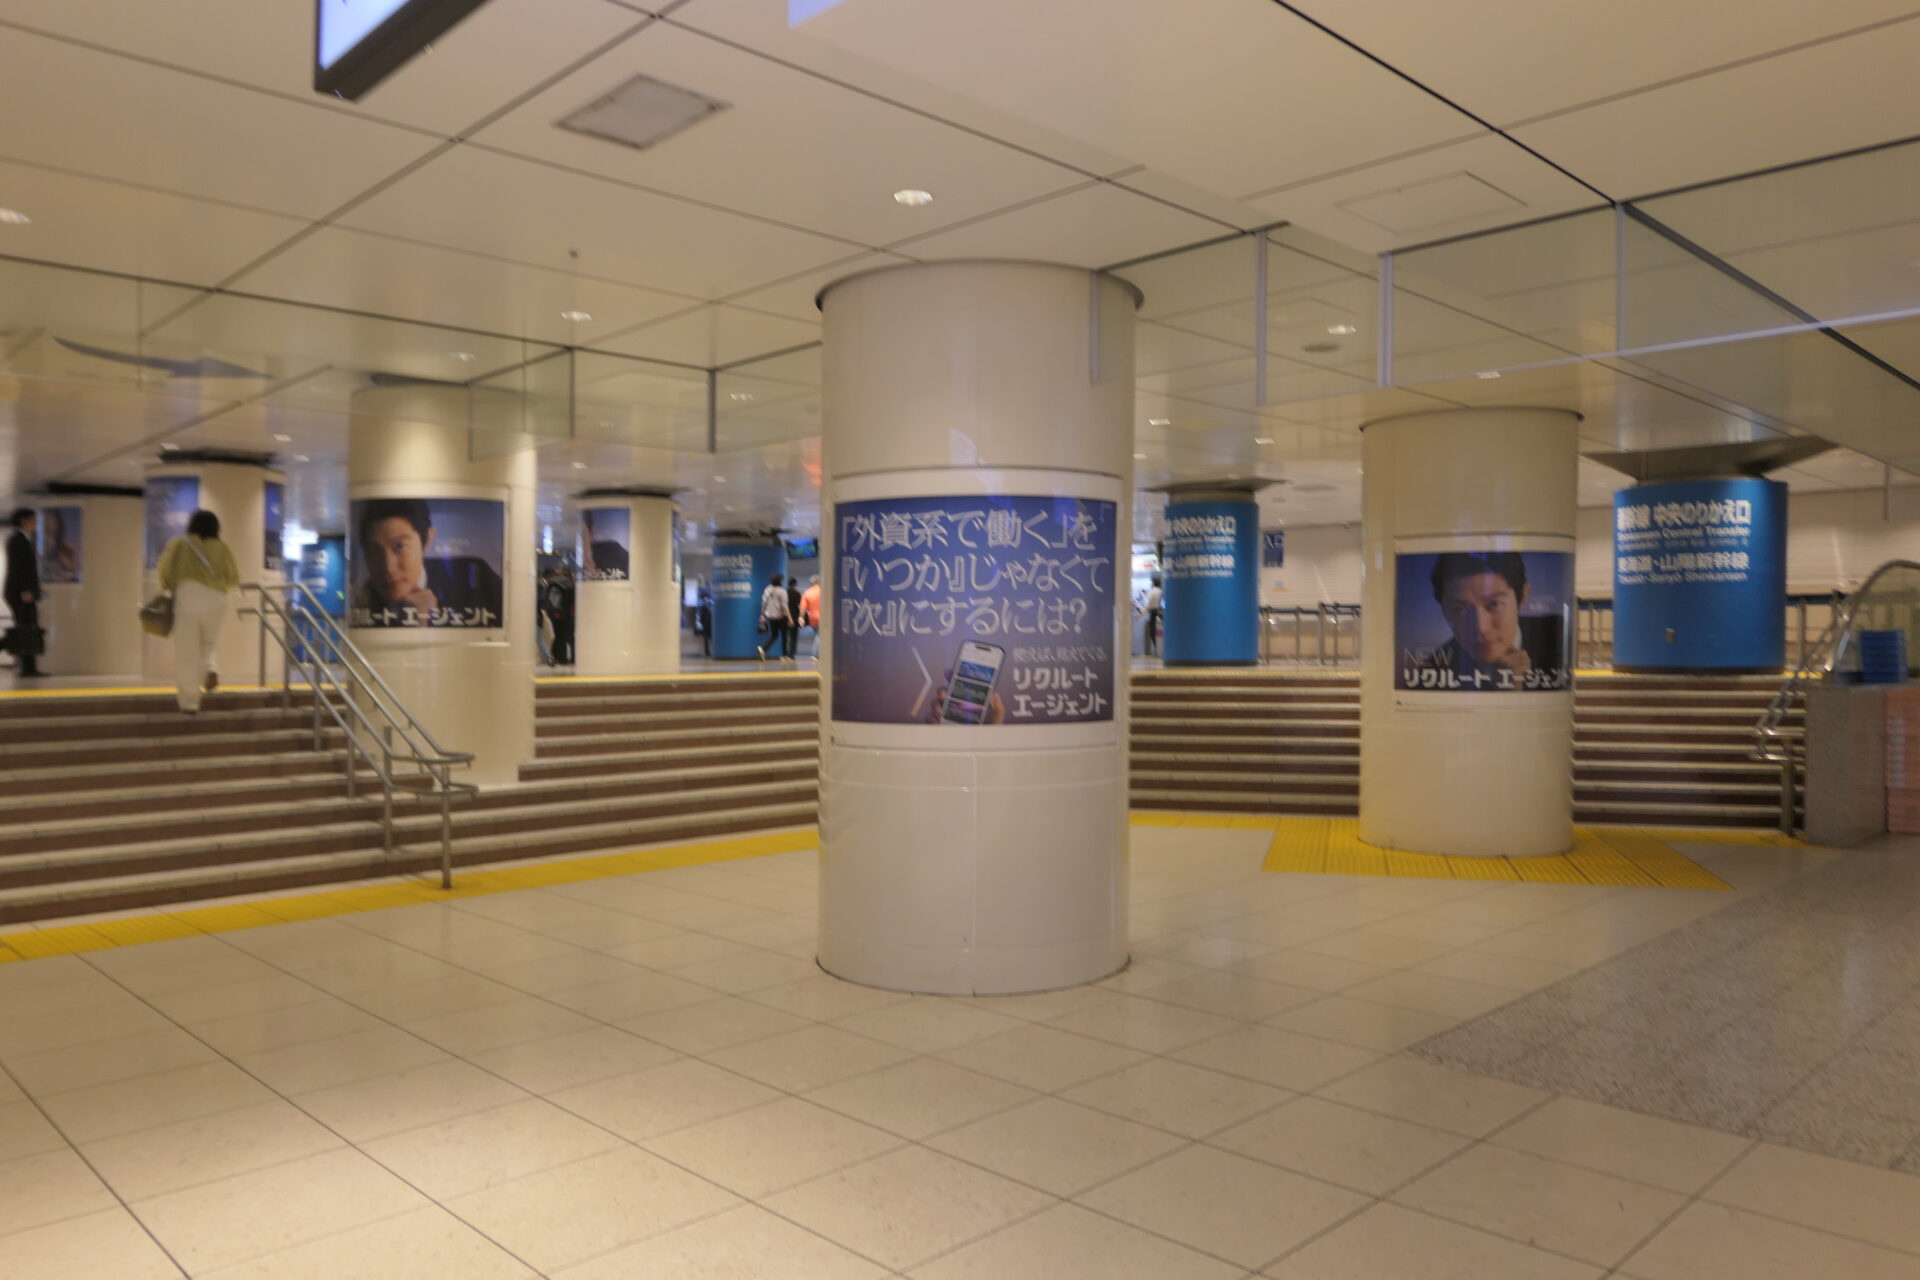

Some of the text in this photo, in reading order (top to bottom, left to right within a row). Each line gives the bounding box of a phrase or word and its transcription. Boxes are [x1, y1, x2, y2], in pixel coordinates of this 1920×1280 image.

[841, 509, 1098, 552] 「外資系で働く」を
[841, 552, 1110, 592] 『いつか』じゃなくて
[402, 607, 496, 626] エージェント
[1013, 667, 1099, 690] リクルート
[1404, 668, 1491, 689] リクルート
[1012, 692, 1108, 718] エージェント
